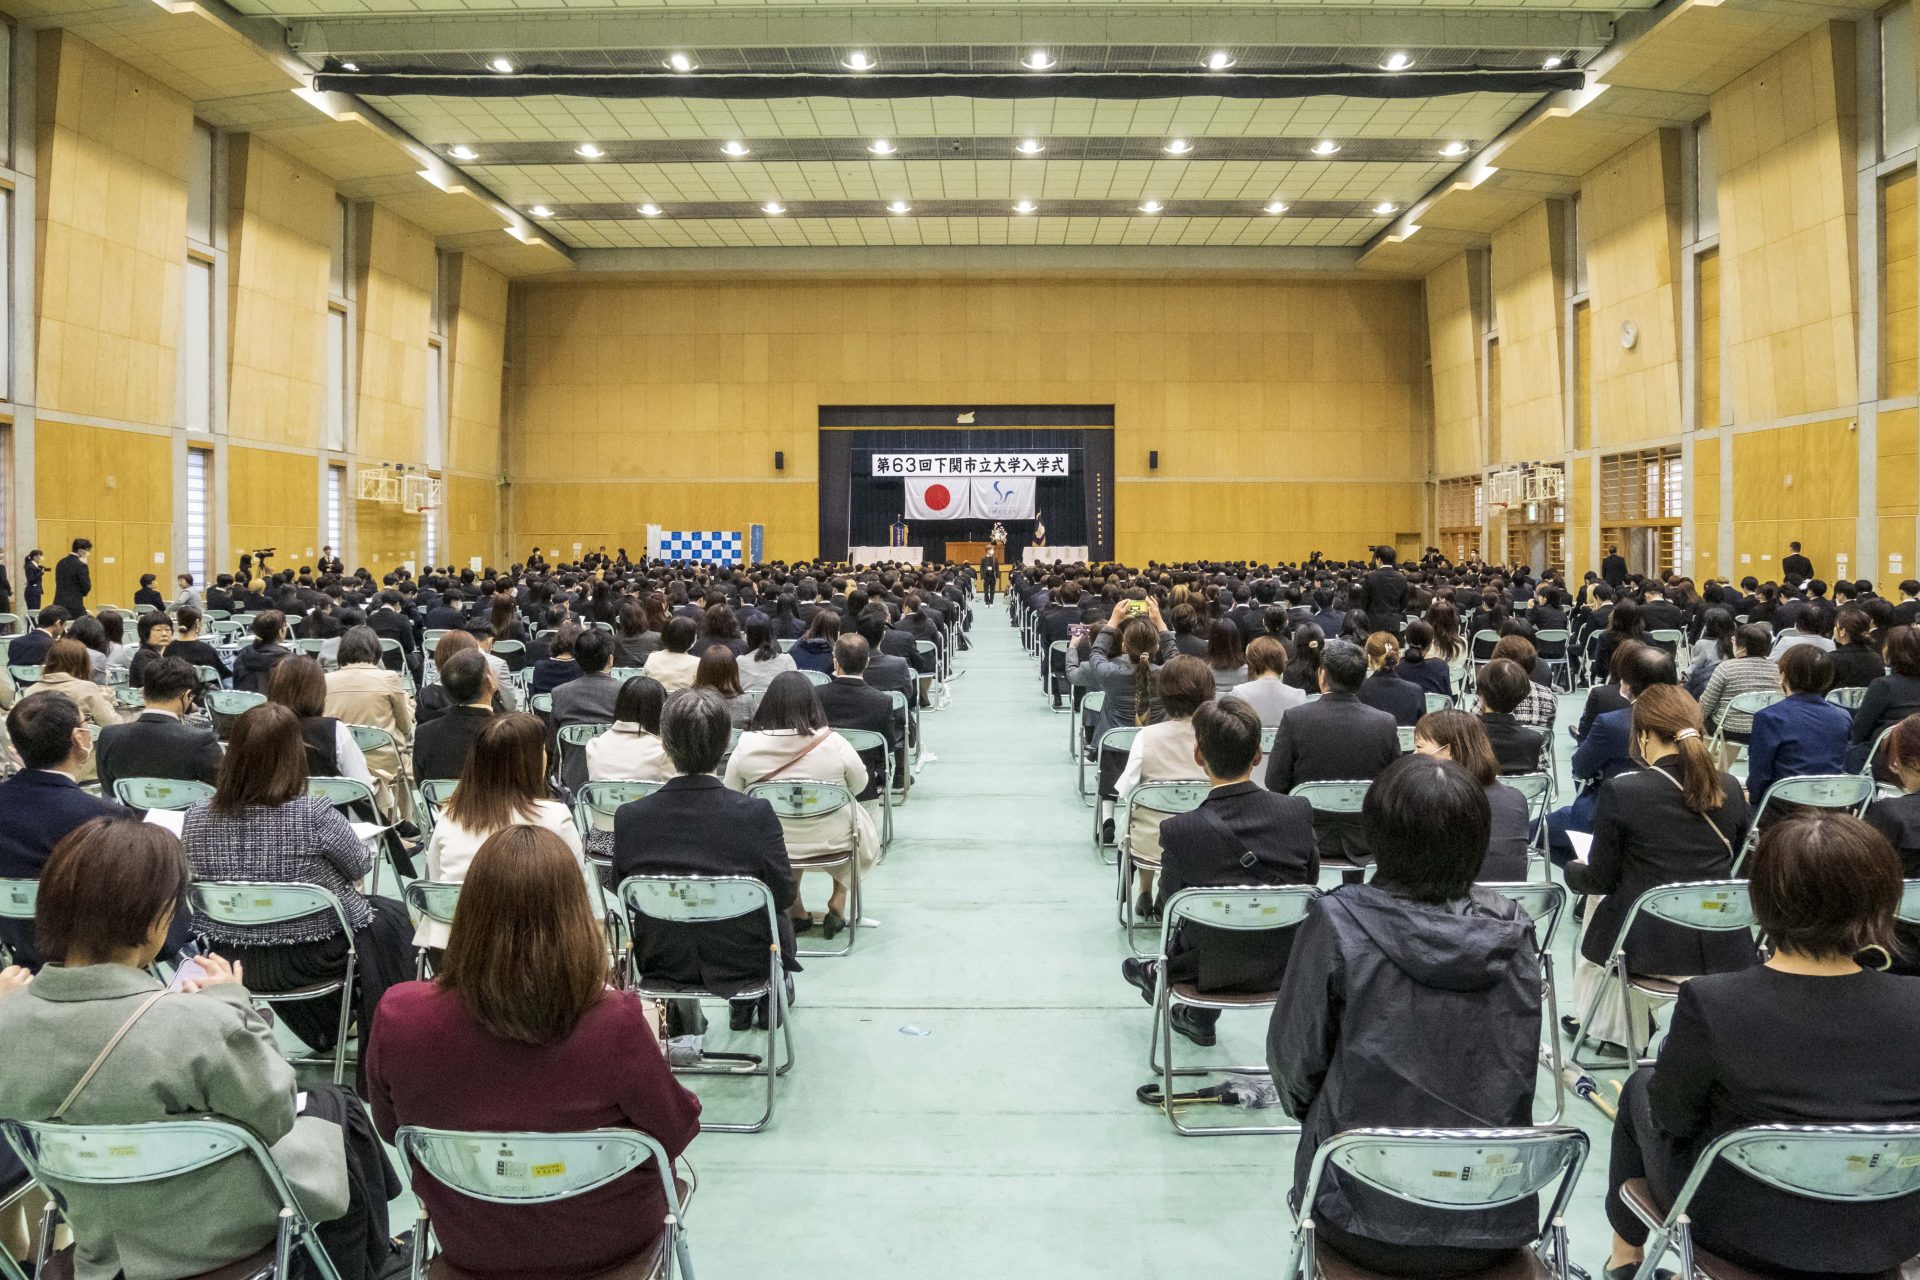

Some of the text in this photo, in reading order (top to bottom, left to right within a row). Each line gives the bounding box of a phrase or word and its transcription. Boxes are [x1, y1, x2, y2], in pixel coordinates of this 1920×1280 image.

[877, 456, 1065, 474] 第63回下関市立大学入学式
